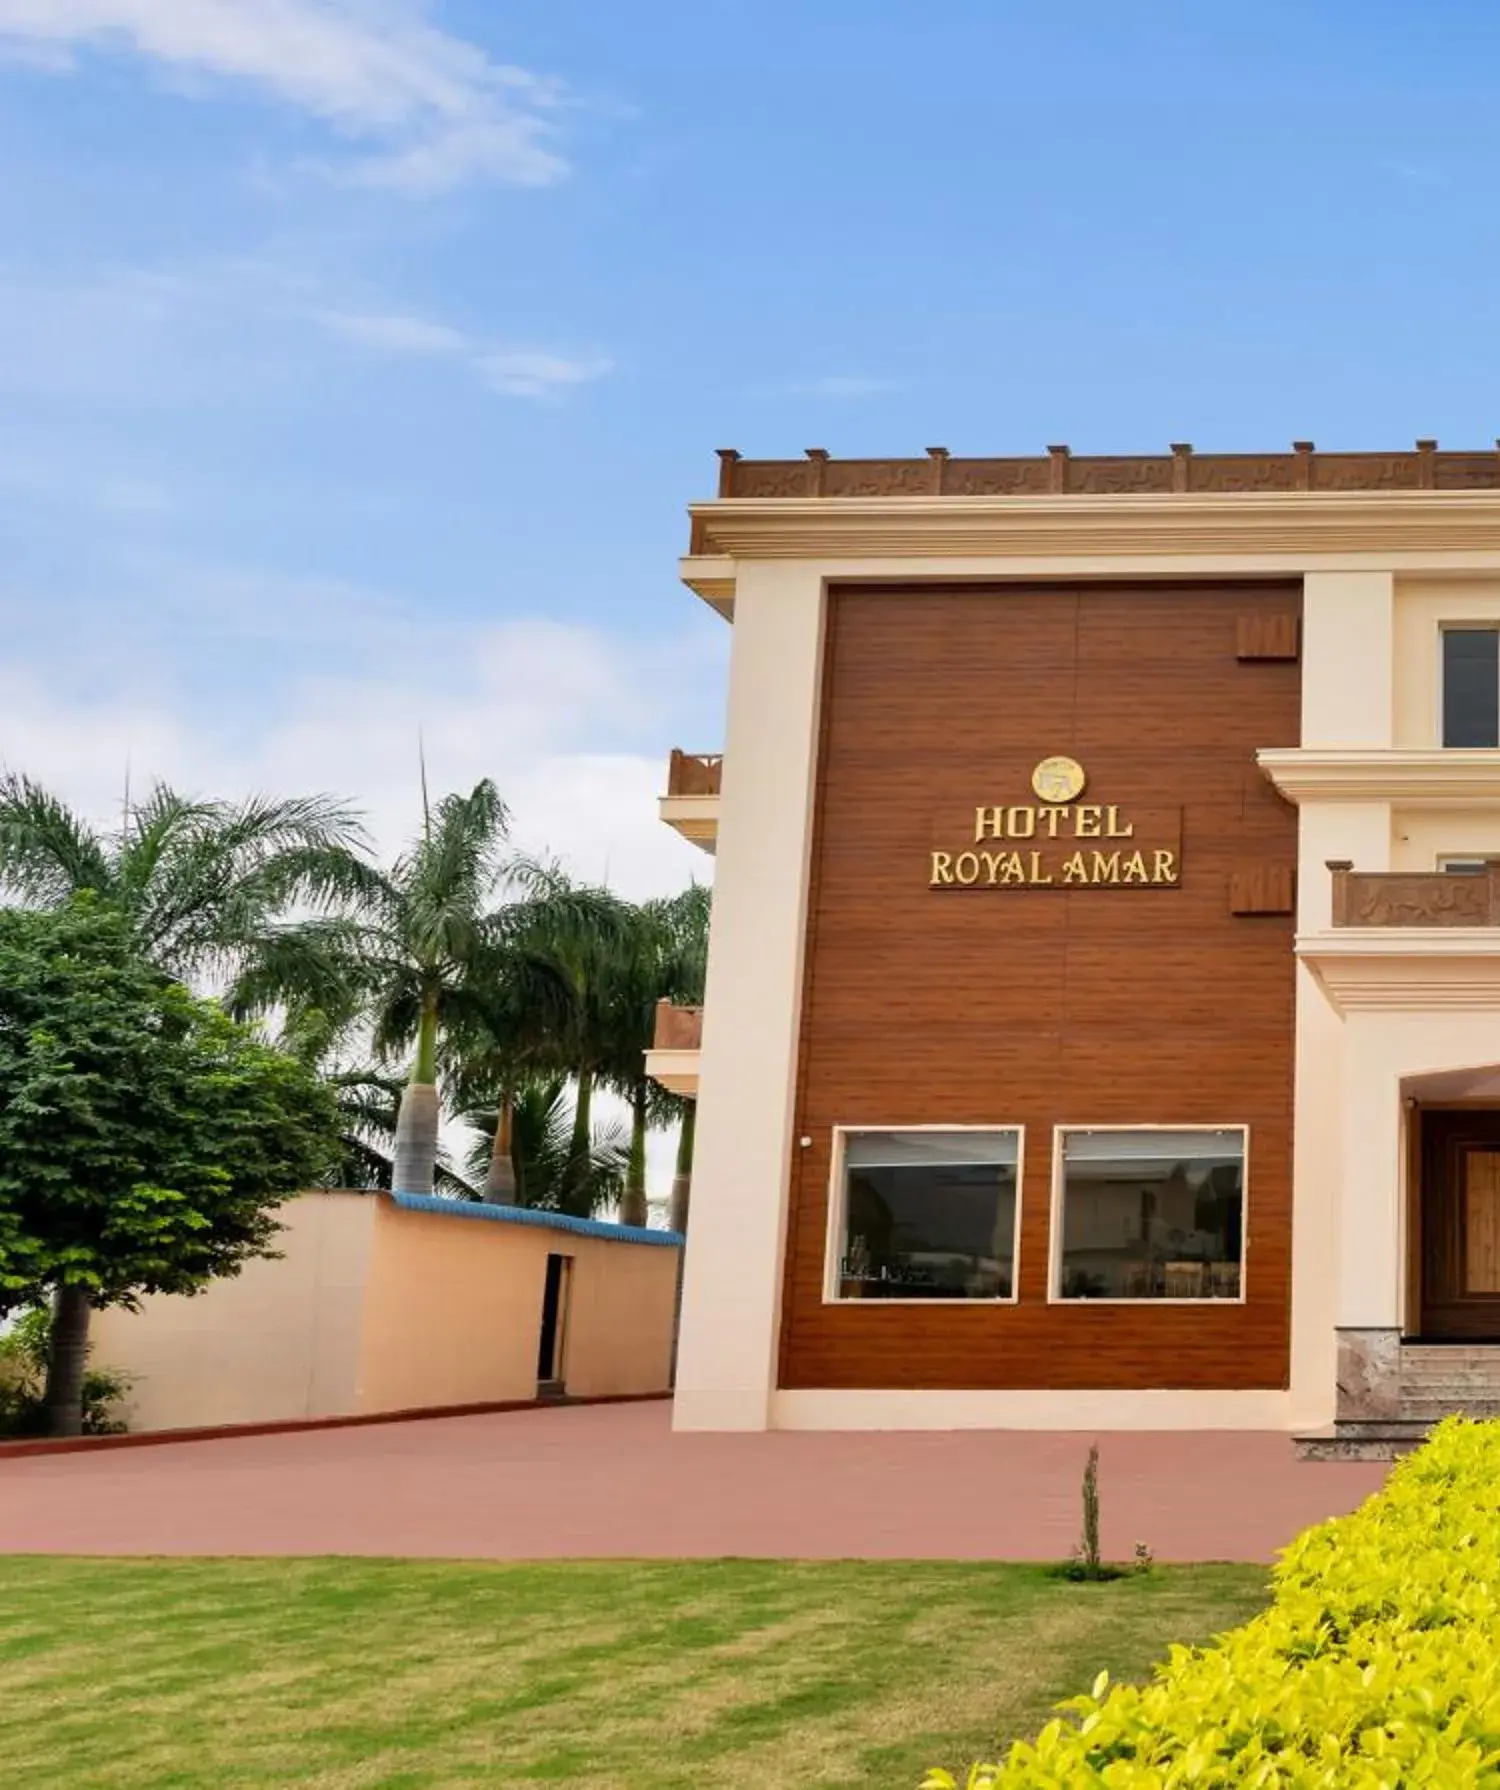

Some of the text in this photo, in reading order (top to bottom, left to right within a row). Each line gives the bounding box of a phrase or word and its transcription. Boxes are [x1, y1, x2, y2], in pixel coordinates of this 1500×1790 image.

[975, 805, 1133, 842] HOTEL
[930, 850, 1177, 885] ROYAL AMAR
